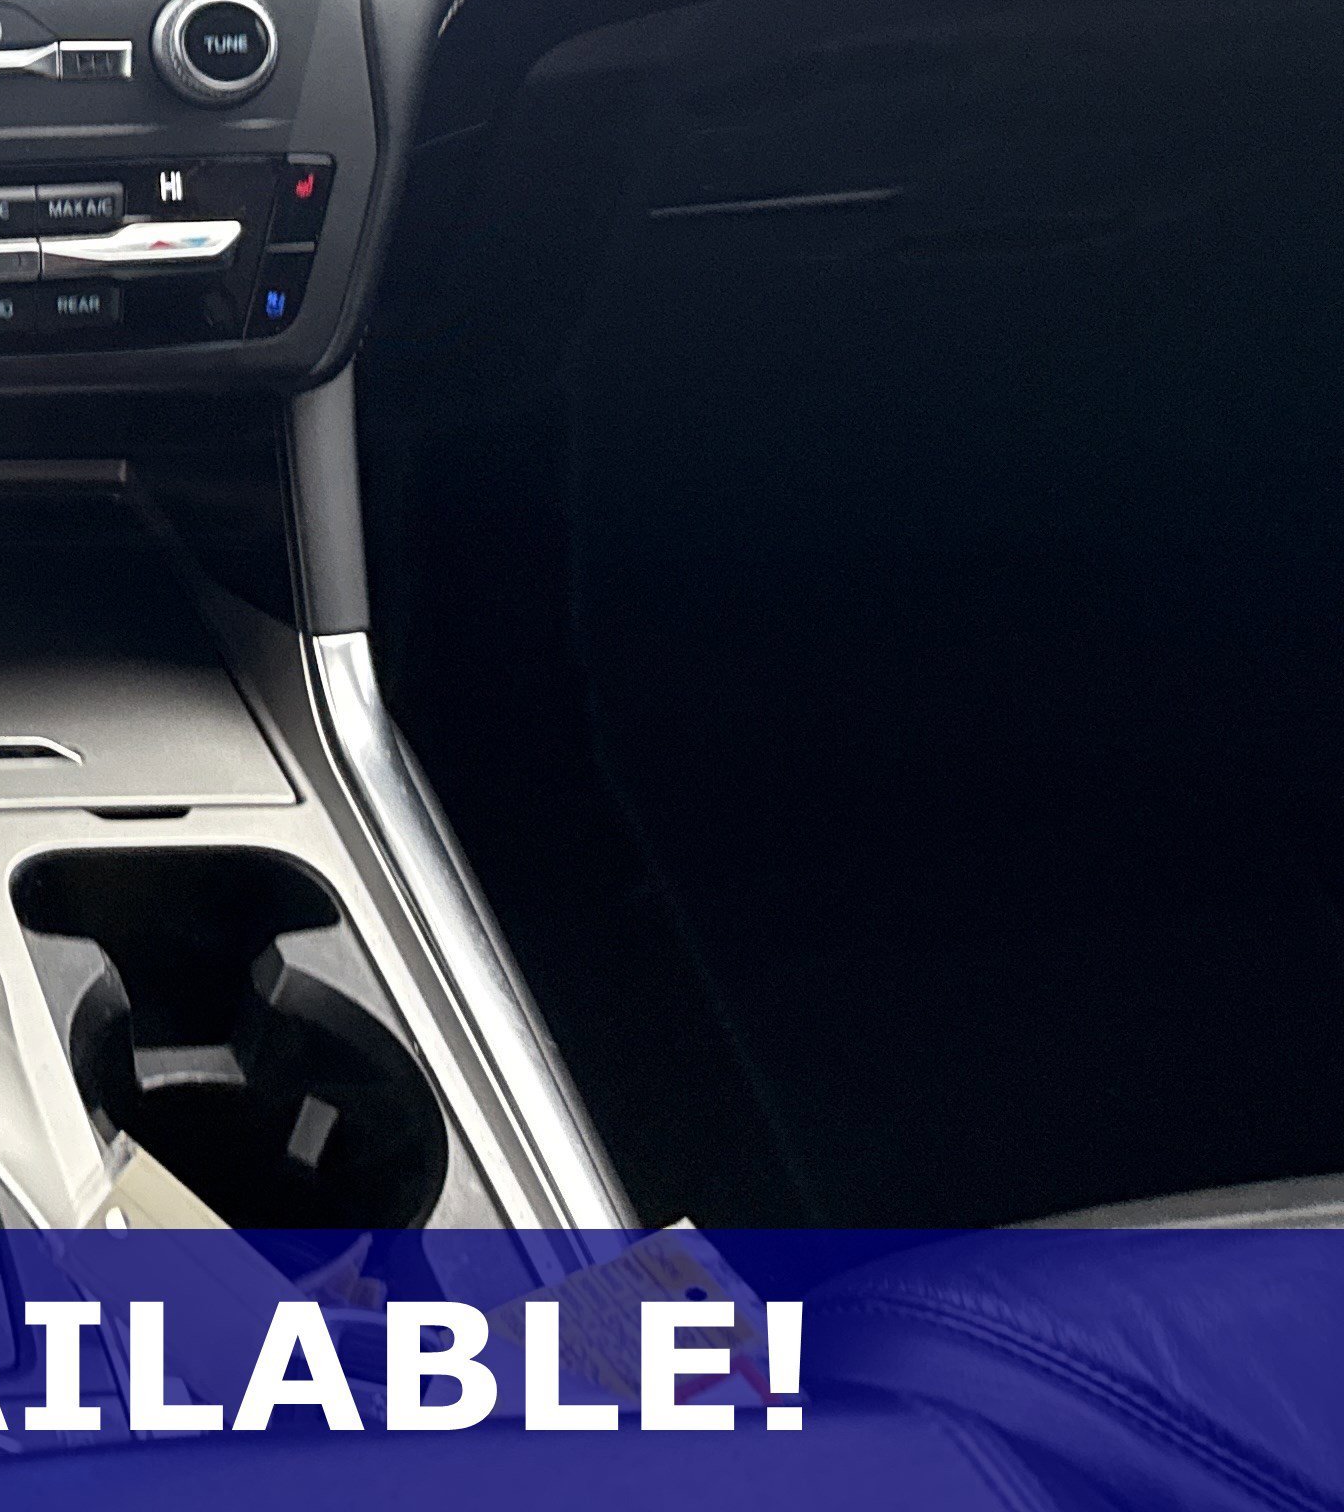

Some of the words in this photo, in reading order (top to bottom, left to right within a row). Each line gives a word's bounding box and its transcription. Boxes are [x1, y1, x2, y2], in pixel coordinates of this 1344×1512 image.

[203, 33, 248, 54] TUNE
[159, 170, 184, 202] HI
[48, 198, 83, 219] MAX
[85, 196, 114, 218] A/C
[57, 293, 102, 315] REAR
